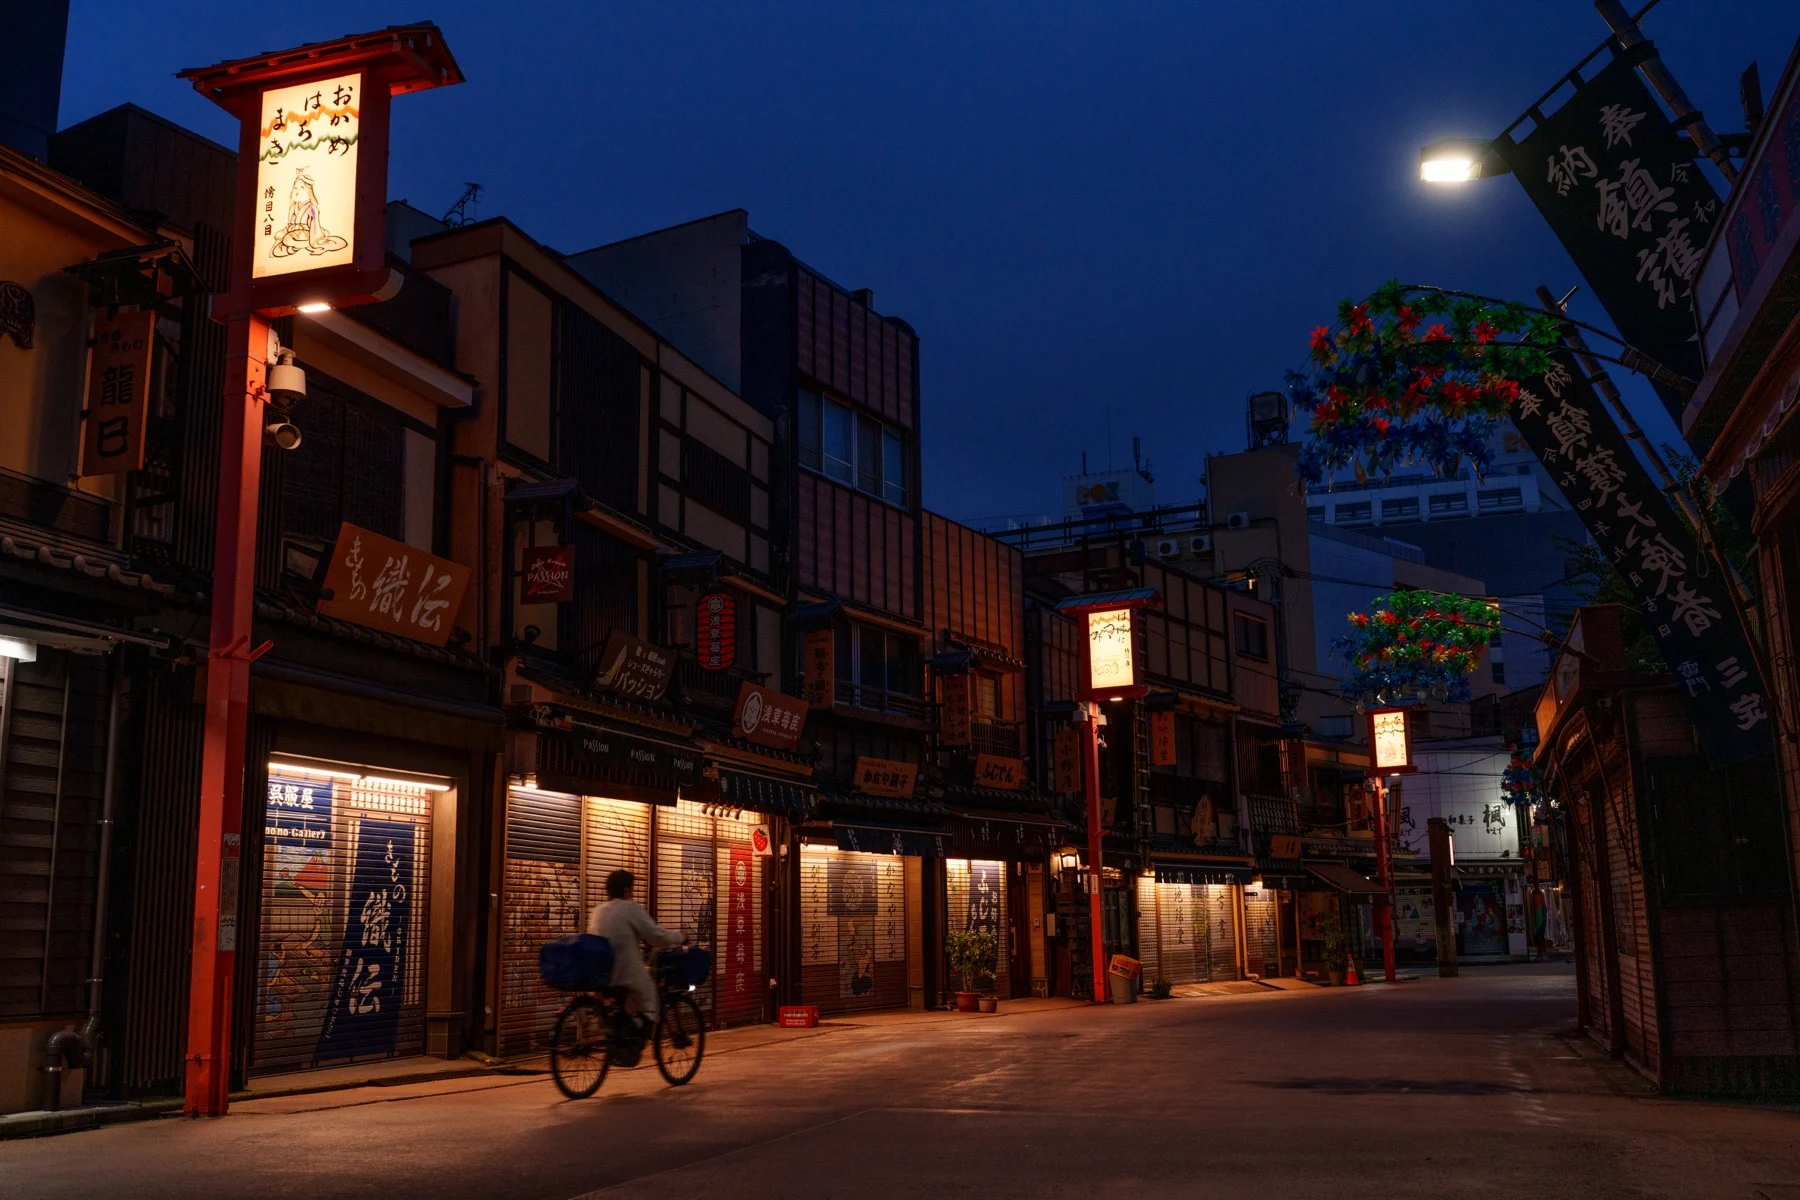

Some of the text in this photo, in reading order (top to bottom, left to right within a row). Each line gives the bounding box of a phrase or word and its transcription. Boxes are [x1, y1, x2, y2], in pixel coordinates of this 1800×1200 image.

[268, 108, 286, 166] まき
[297, 91, 322, 142] はち
[328, 84, 354, 157] おかめ
[1547, 103, 1647, 197] 奉納
[1670, 160, 1717, 225] 令和
[368, 553, 451, 632] 織伝
[527, 570, 569, 583] PASSION
[614, 671, 667, 701] パッション
[268, 783, 314, 810] 呉服屋
[1482, 803, 1506, 828] 楓
[349, 888, 392, 1015] 織伝
